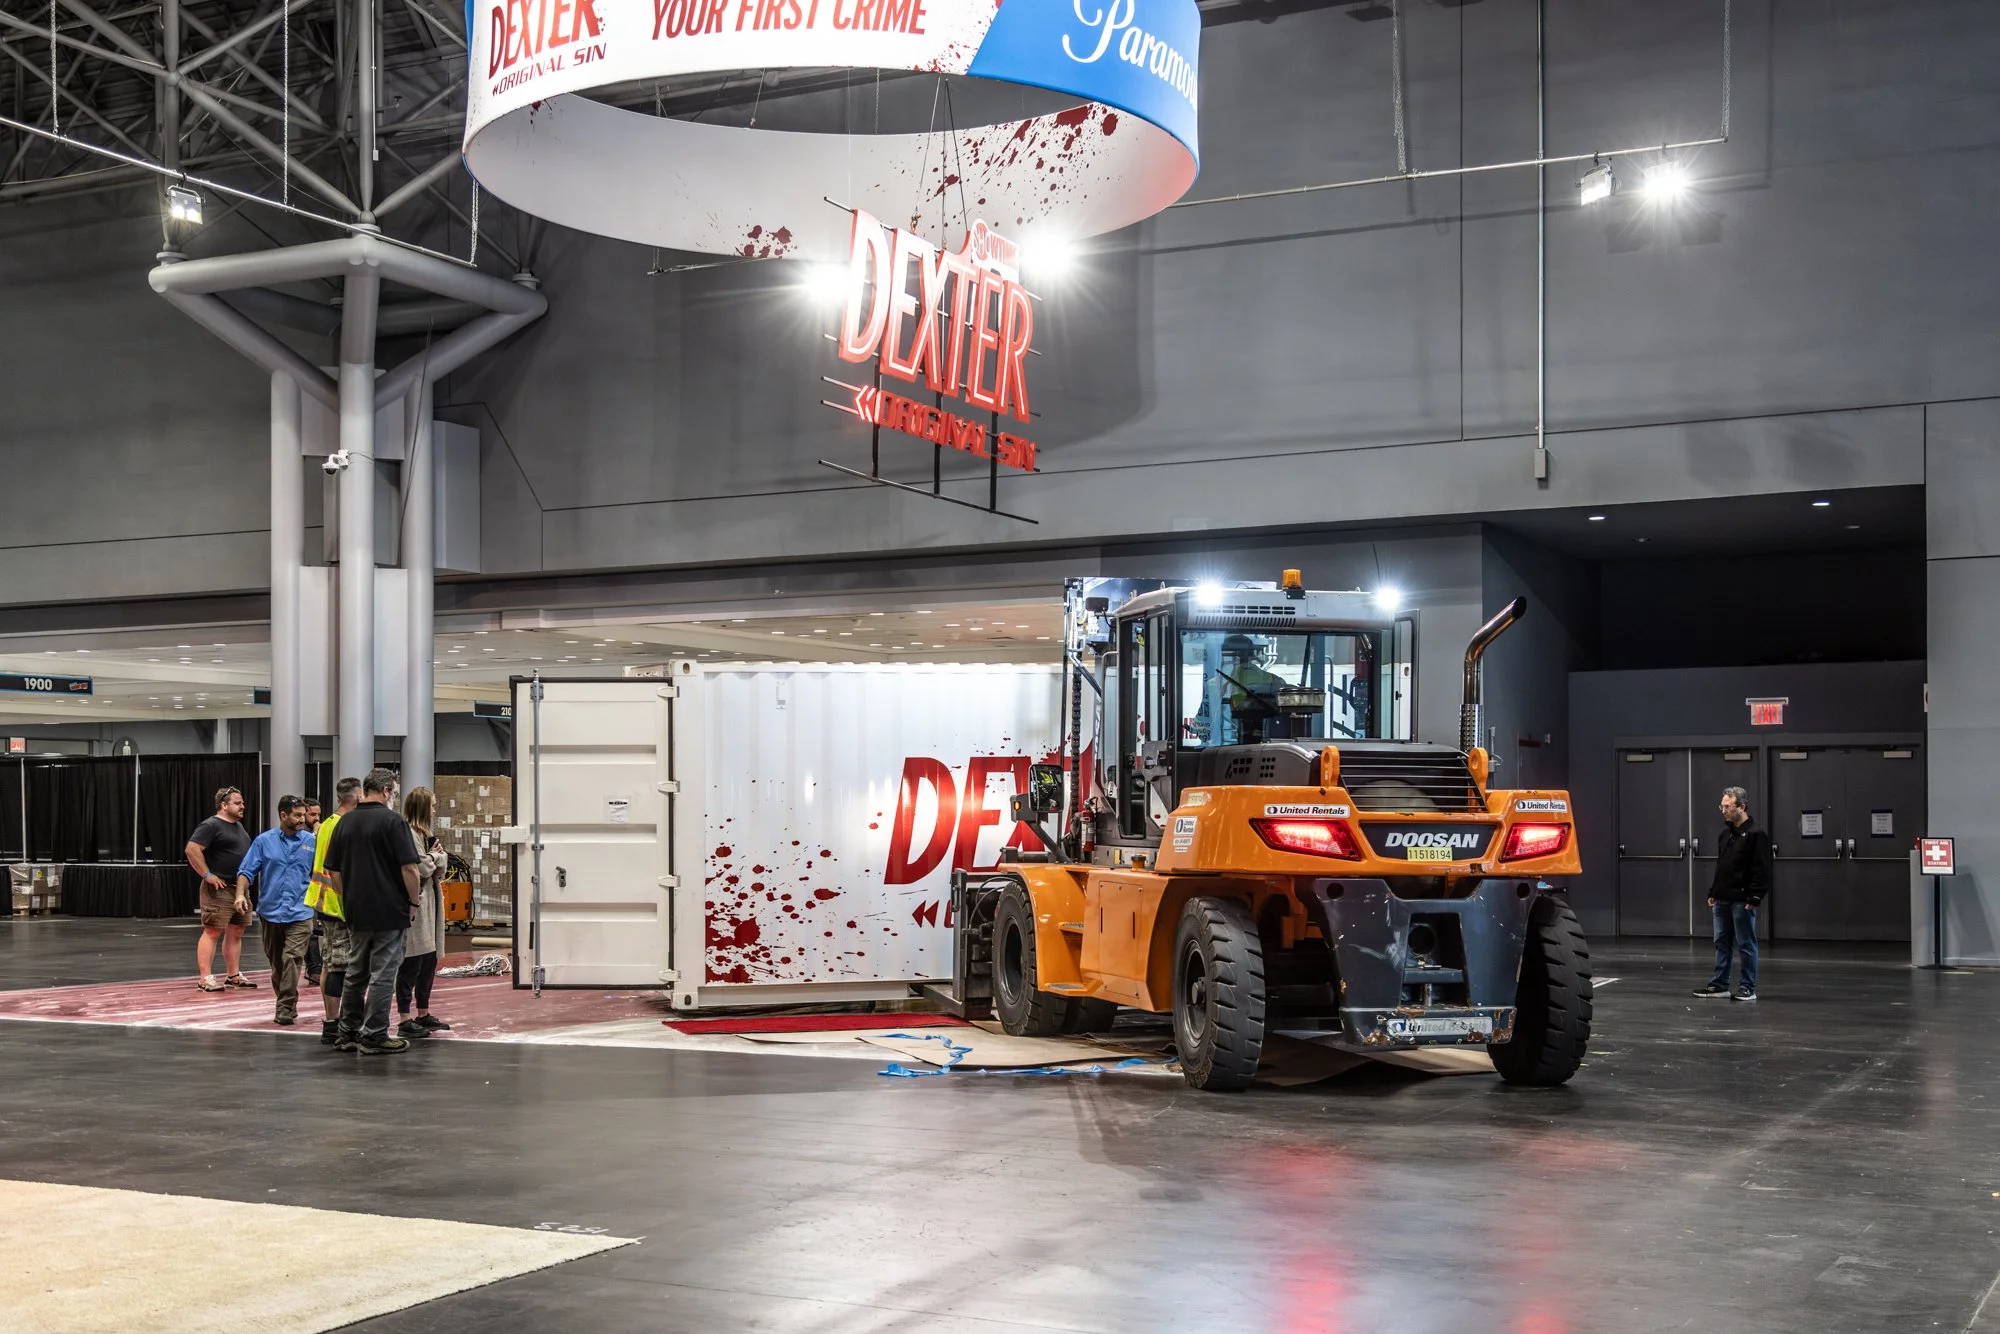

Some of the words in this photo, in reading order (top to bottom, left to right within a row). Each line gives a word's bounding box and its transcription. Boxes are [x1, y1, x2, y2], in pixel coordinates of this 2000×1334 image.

[652, 0, 727, 40] YOUR
[735, 0, 820, 31] FIRST
[832, 0, 926, 35] CRIME
[489, 0, 601, 80] DEXTER
[499, 55, 566, 95] ORIGINAL
[573, 43, 607, 67] SIN
[838, 208, 1034, 425] DEXTER
[874, 390, 991, 459] ORIGINAL
[997, 432, 1037, 473] SIN
[24, 677, 53, 691] 1900
[1755, 704, 1780, 723] EXIT
[1280, 806, 1310, 815] United
[1311, 806, 1346, 815] Rentals
[1527, 801, 1549, 809] United
[1549, 802, 1567, 811] Rentals
[1385, 832, 1480, 848] DOOSAN
[1408, 848, 1452, 860] 11518194
[1408, 1022, 1446, 1033] United
